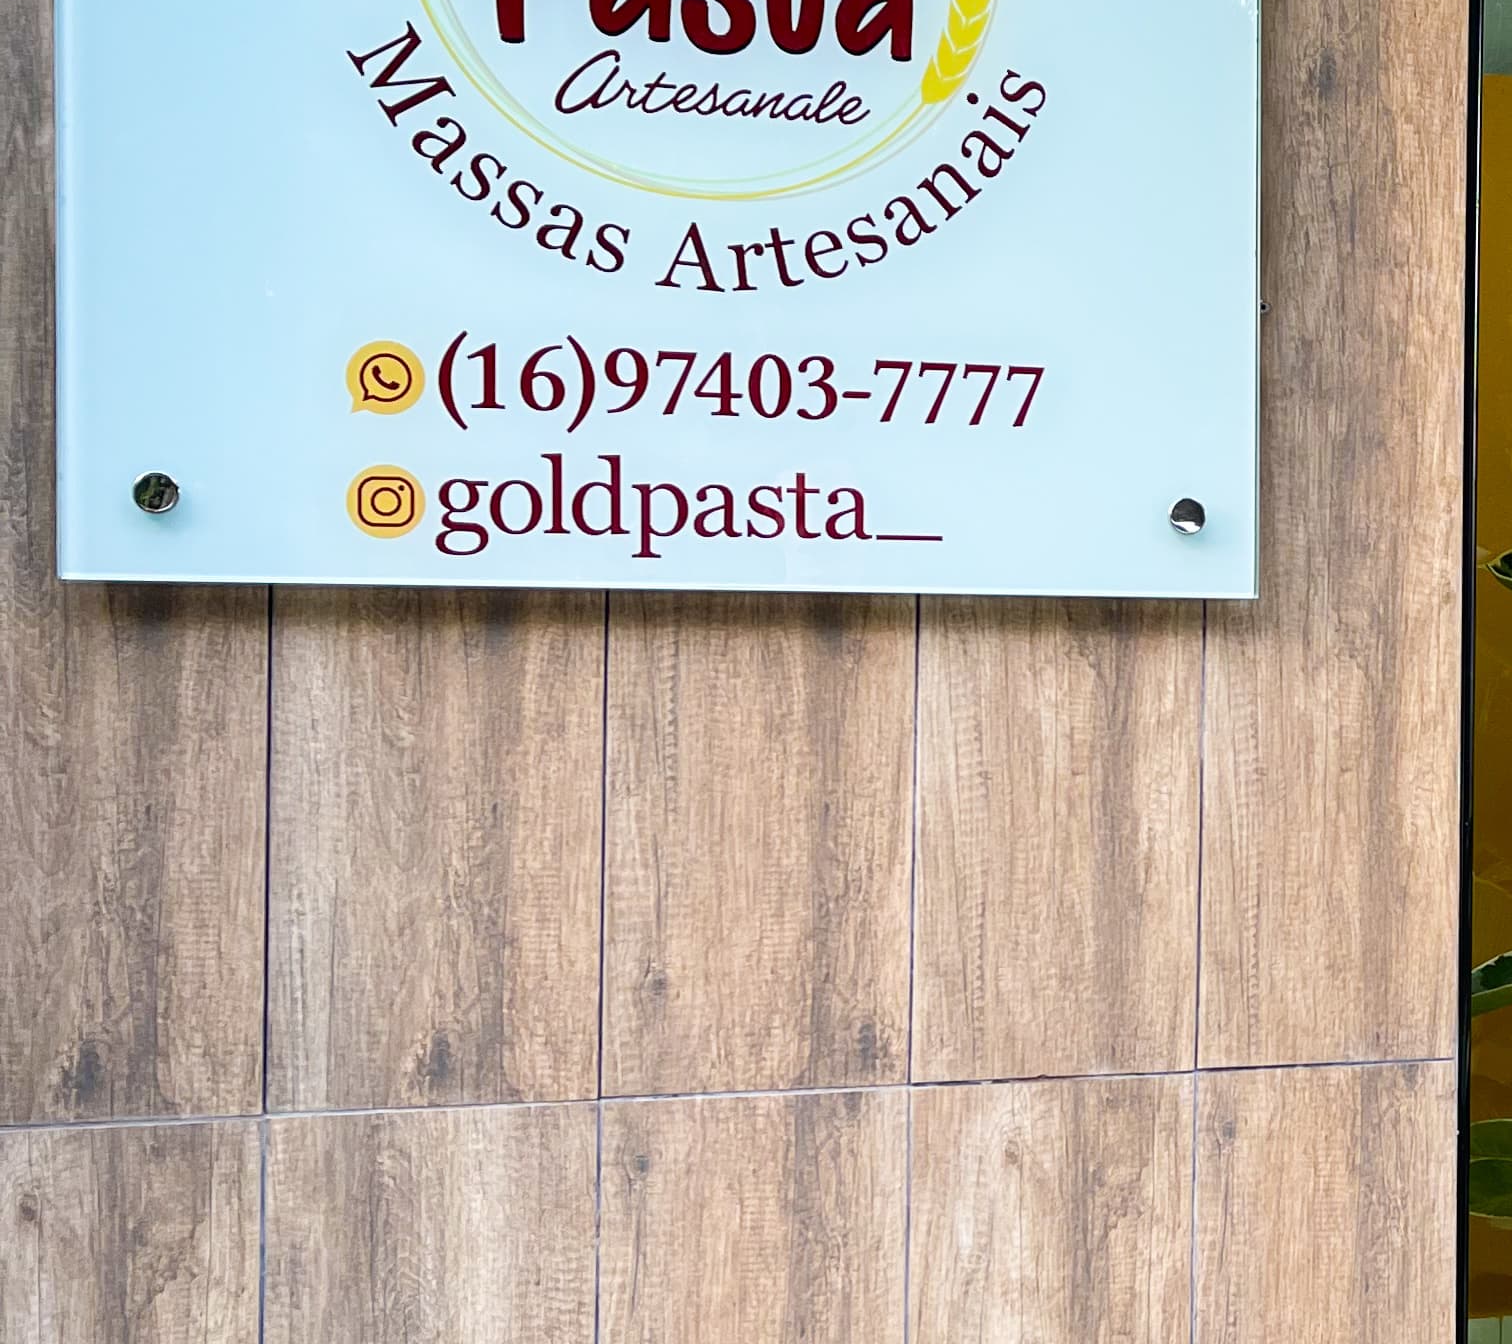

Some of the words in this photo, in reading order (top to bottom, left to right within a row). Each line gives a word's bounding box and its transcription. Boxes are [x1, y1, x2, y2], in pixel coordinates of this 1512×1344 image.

[554, 48, 872, 127] Artesanale
[346, 20, 632, 274] Massas
[655, 68, 1048, 294] Artesanais
[437, 330, 1046, 434] (16)97403-7777
